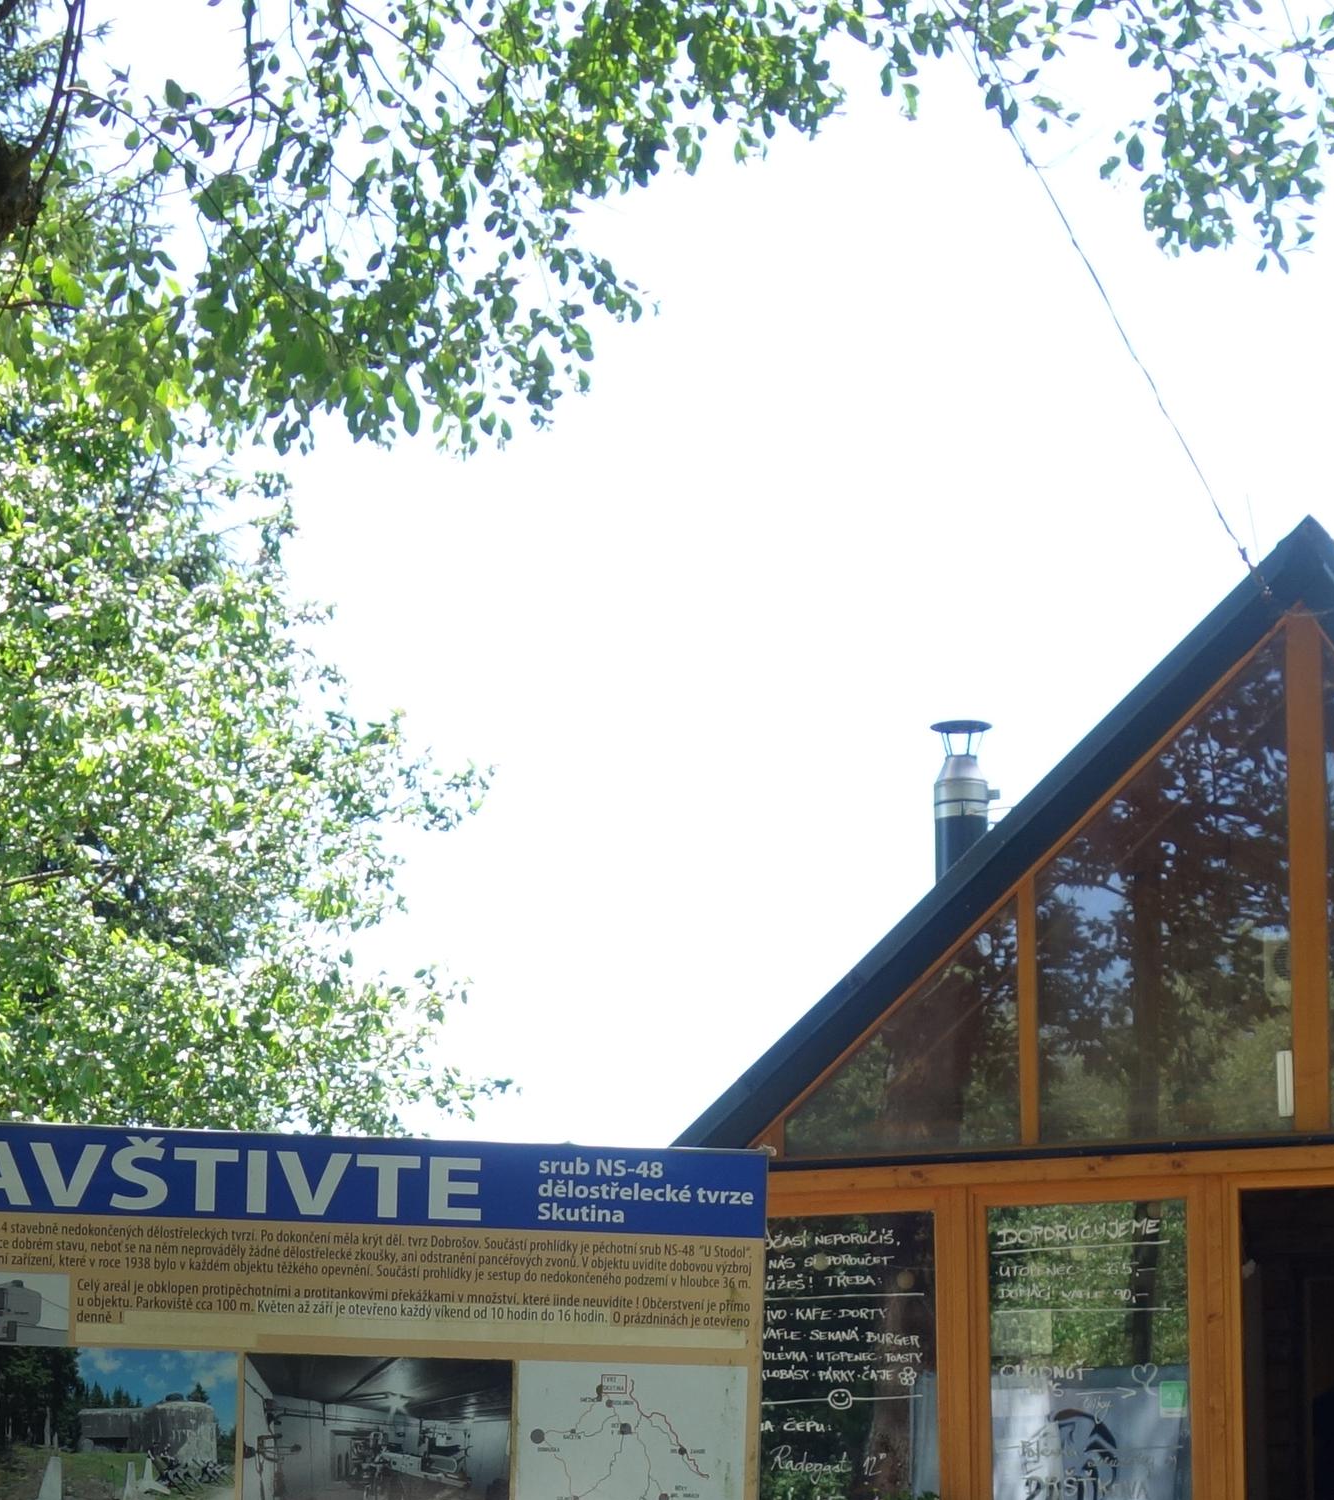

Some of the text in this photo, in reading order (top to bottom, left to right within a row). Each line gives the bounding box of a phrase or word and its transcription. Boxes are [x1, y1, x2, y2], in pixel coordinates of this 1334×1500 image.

[539, 1157, 663, 1178] srub NS-48
[537, 1179, 754, 1205] dělostřelecké tvrze
[537, 1203, 625, 1224] Skutina
[260, 1228, 274, 1243] Po
[580, 1239, 590, 1256] je
[474, 1267, 485, 1285] je
[523, 1269, 538, 1283] do
[722, 1276, 736, 1290] 36
[737, 1280, 752, 1291] m.
[765, 1274, 813, 1291] ŮŽEŠ!
[766, 1306, 787, 1321] IVO
[796, 1308, 832, 1320] KAFE
[867, 1332, 921, 1346] BURGER
[764, 1346, 808, 1362] OLÉVKA
[770, 1445, 852, 1484] Radegast
